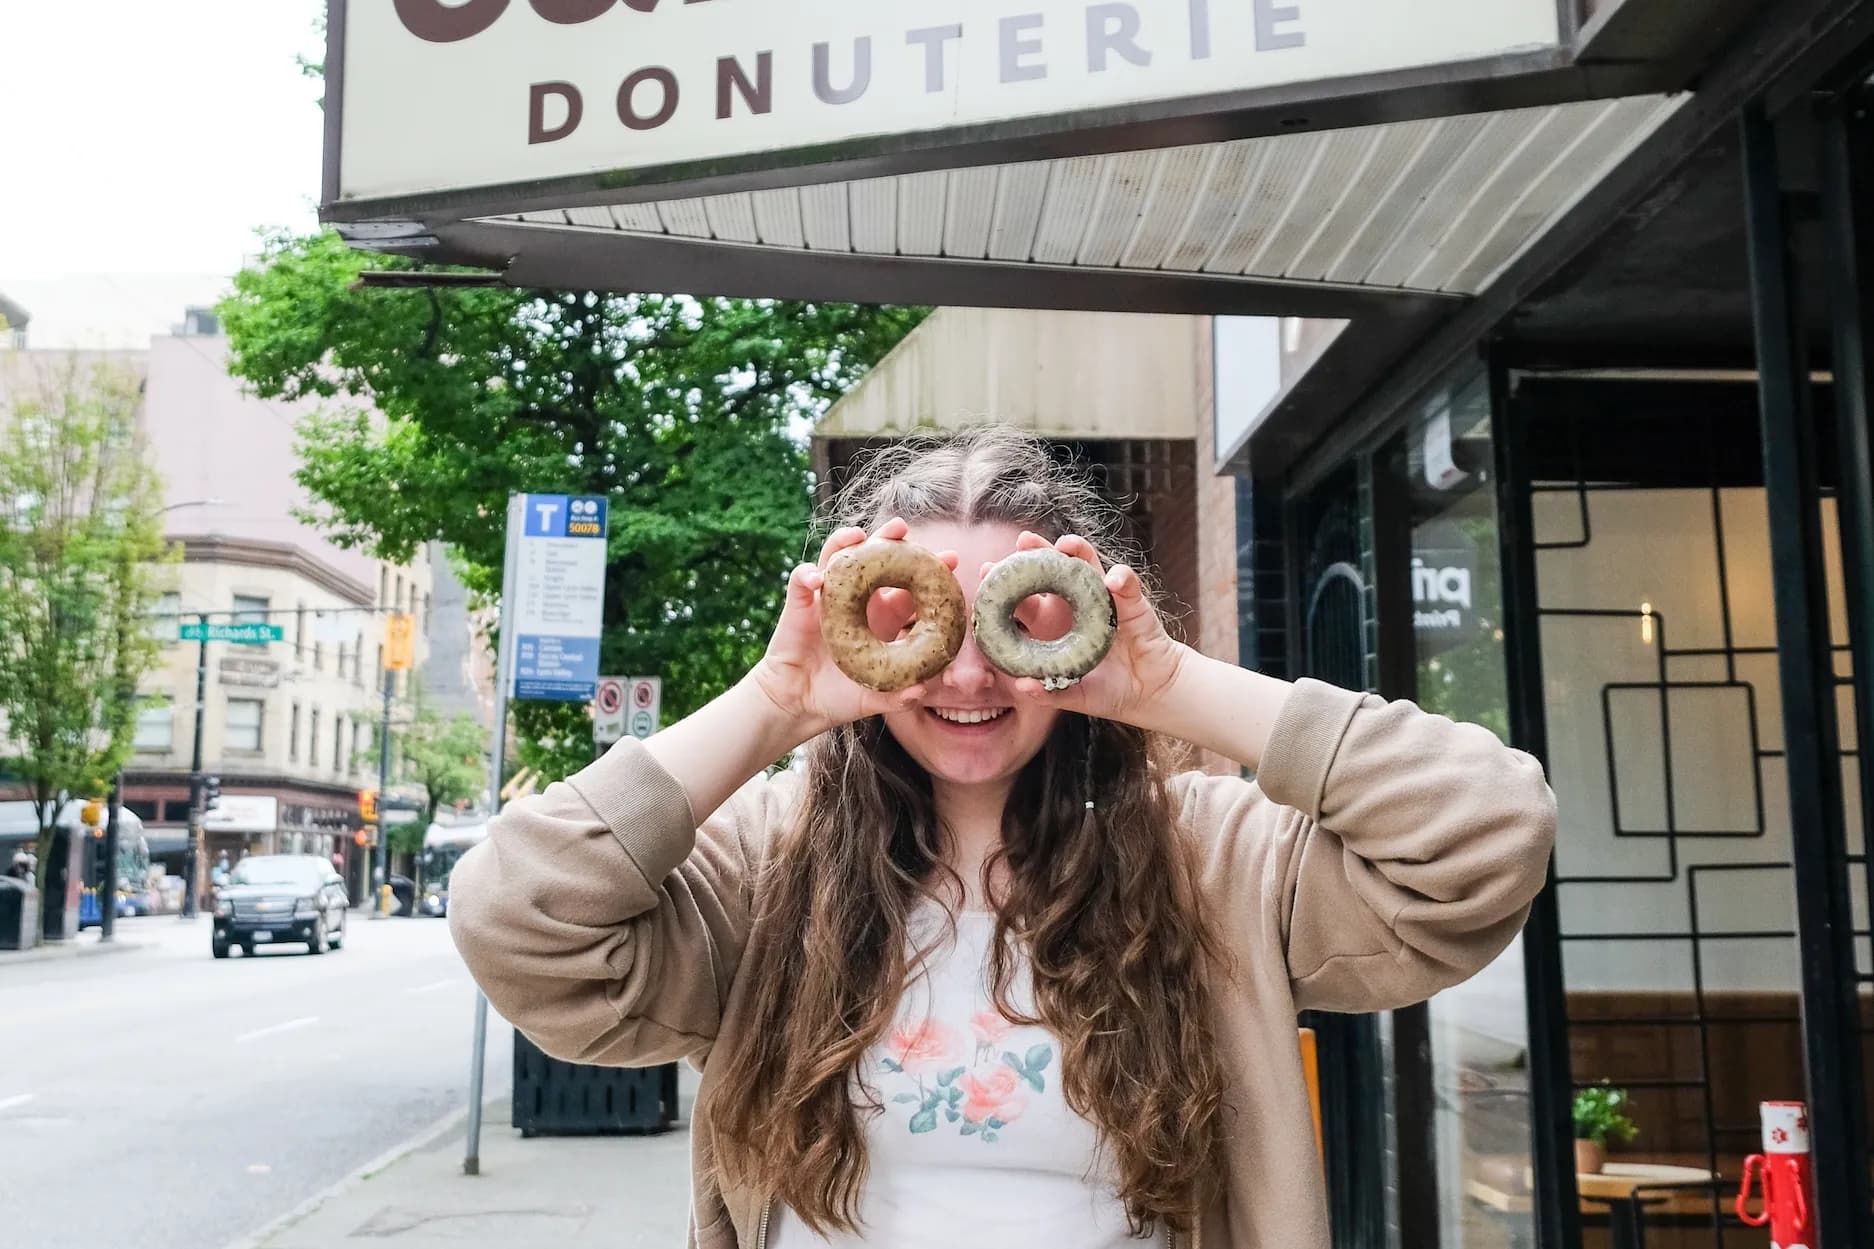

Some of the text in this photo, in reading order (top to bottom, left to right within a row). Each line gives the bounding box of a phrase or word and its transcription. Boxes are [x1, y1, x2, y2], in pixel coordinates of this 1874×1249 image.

[528, 0, 1306, 145] DONUTERIE
[536, 504, 558, 531] T
[569, 523, 599, 534] 50078
[207, 625, 257, 640] Richards
